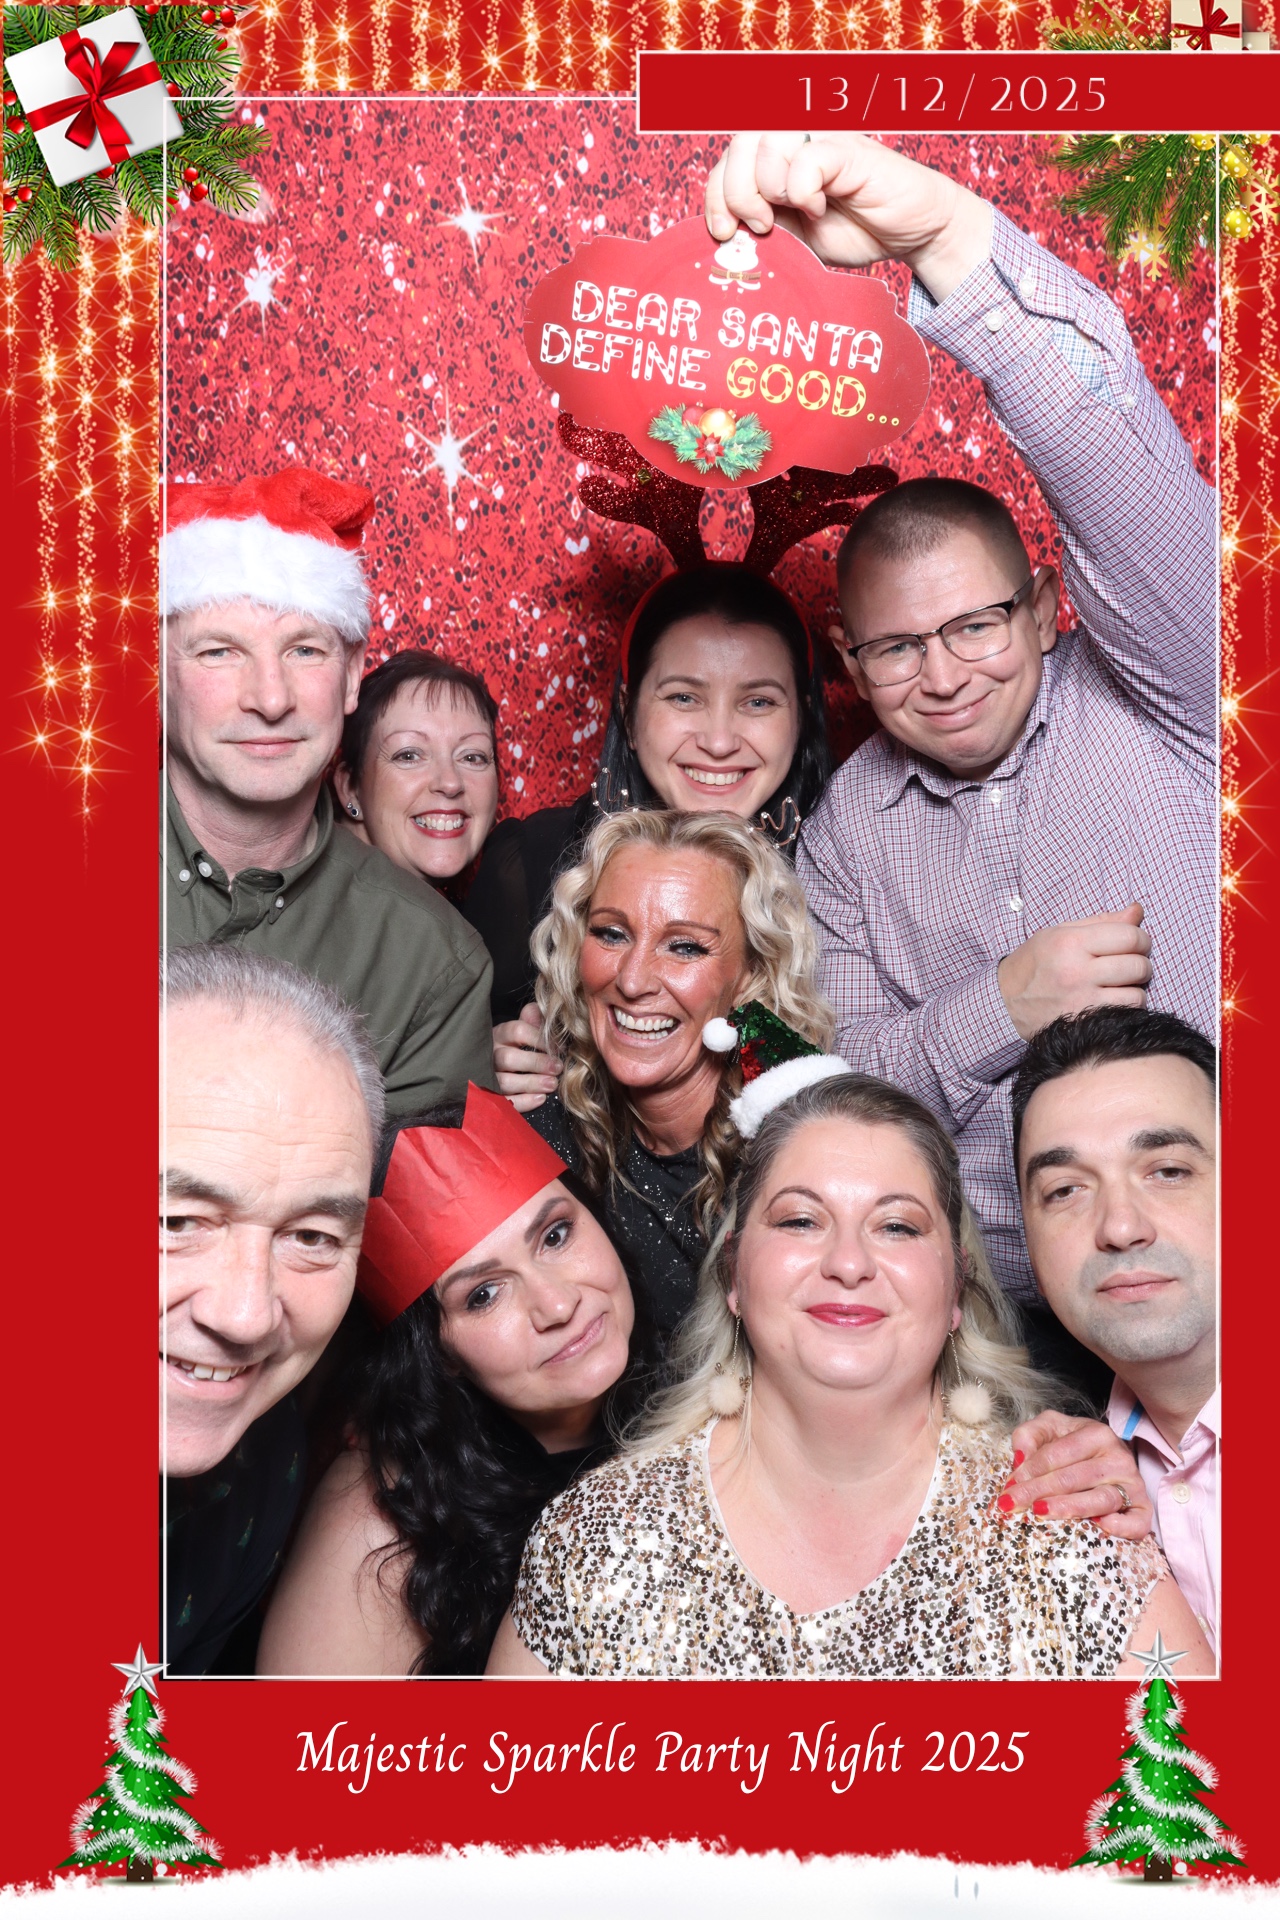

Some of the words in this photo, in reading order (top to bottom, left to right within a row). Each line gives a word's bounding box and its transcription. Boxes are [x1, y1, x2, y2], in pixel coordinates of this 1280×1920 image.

[539, 322, 711, 392] DEFINE
[726, 356, 900, 427] GOOD...
[572, 279, 701, 341] DEAR
[717, 306, 883, 374] SANTA
